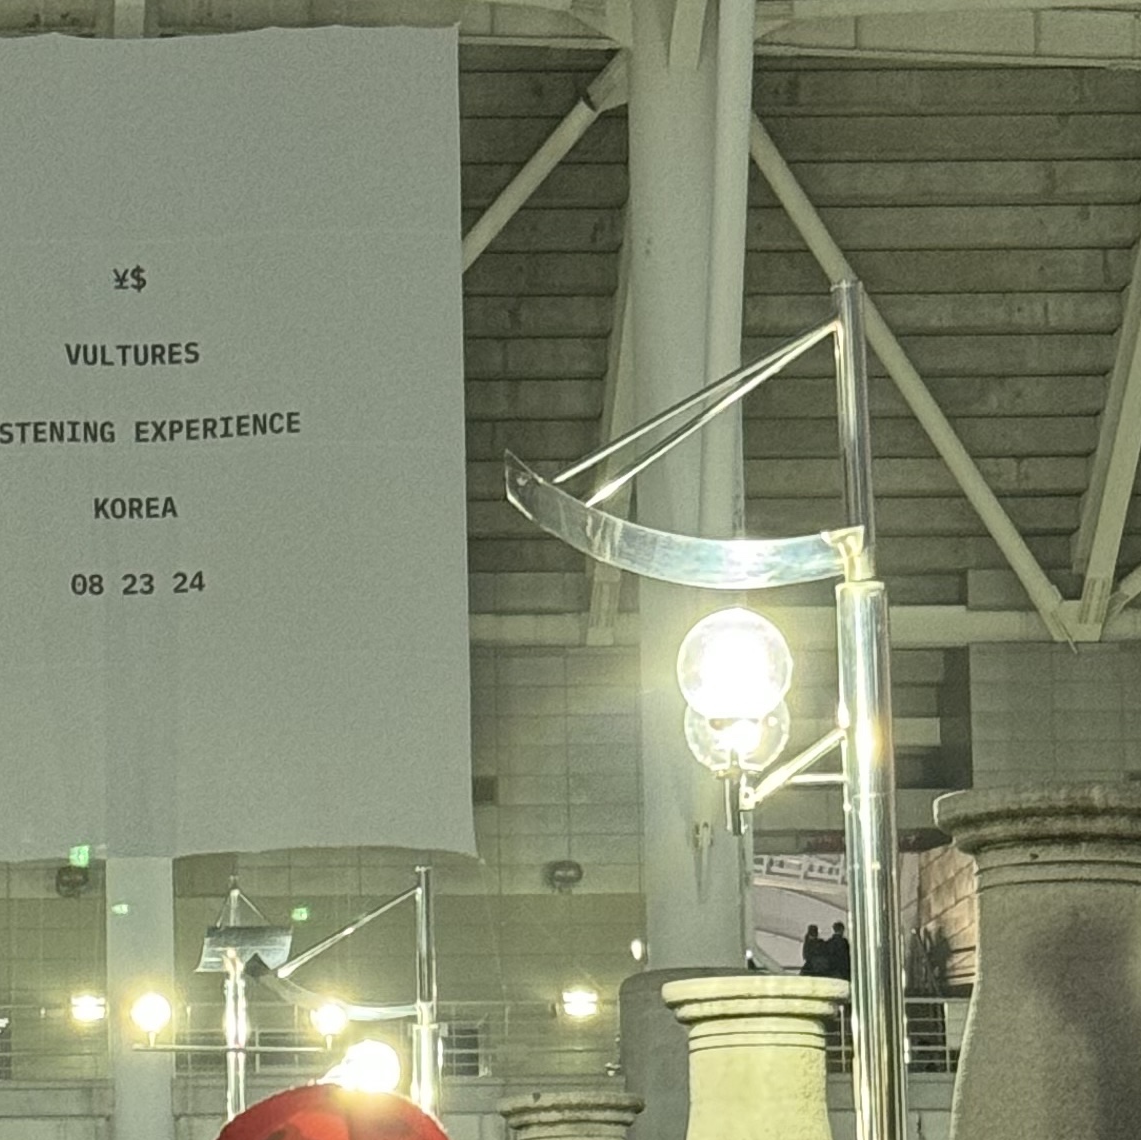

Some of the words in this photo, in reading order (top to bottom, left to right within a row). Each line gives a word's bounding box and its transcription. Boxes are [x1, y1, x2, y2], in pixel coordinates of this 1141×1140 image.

[113, 265, 147, 292] ¥$
[65, 342, 200, 366] VULTURES
[134, 411, 301, 443] EXPERIENCE
[93, 497, 178, 519] KOREA
[71, 574, 104, 596] 08
[121, 573, 155, 596] 23
[172, 570, 206, 594] 24
